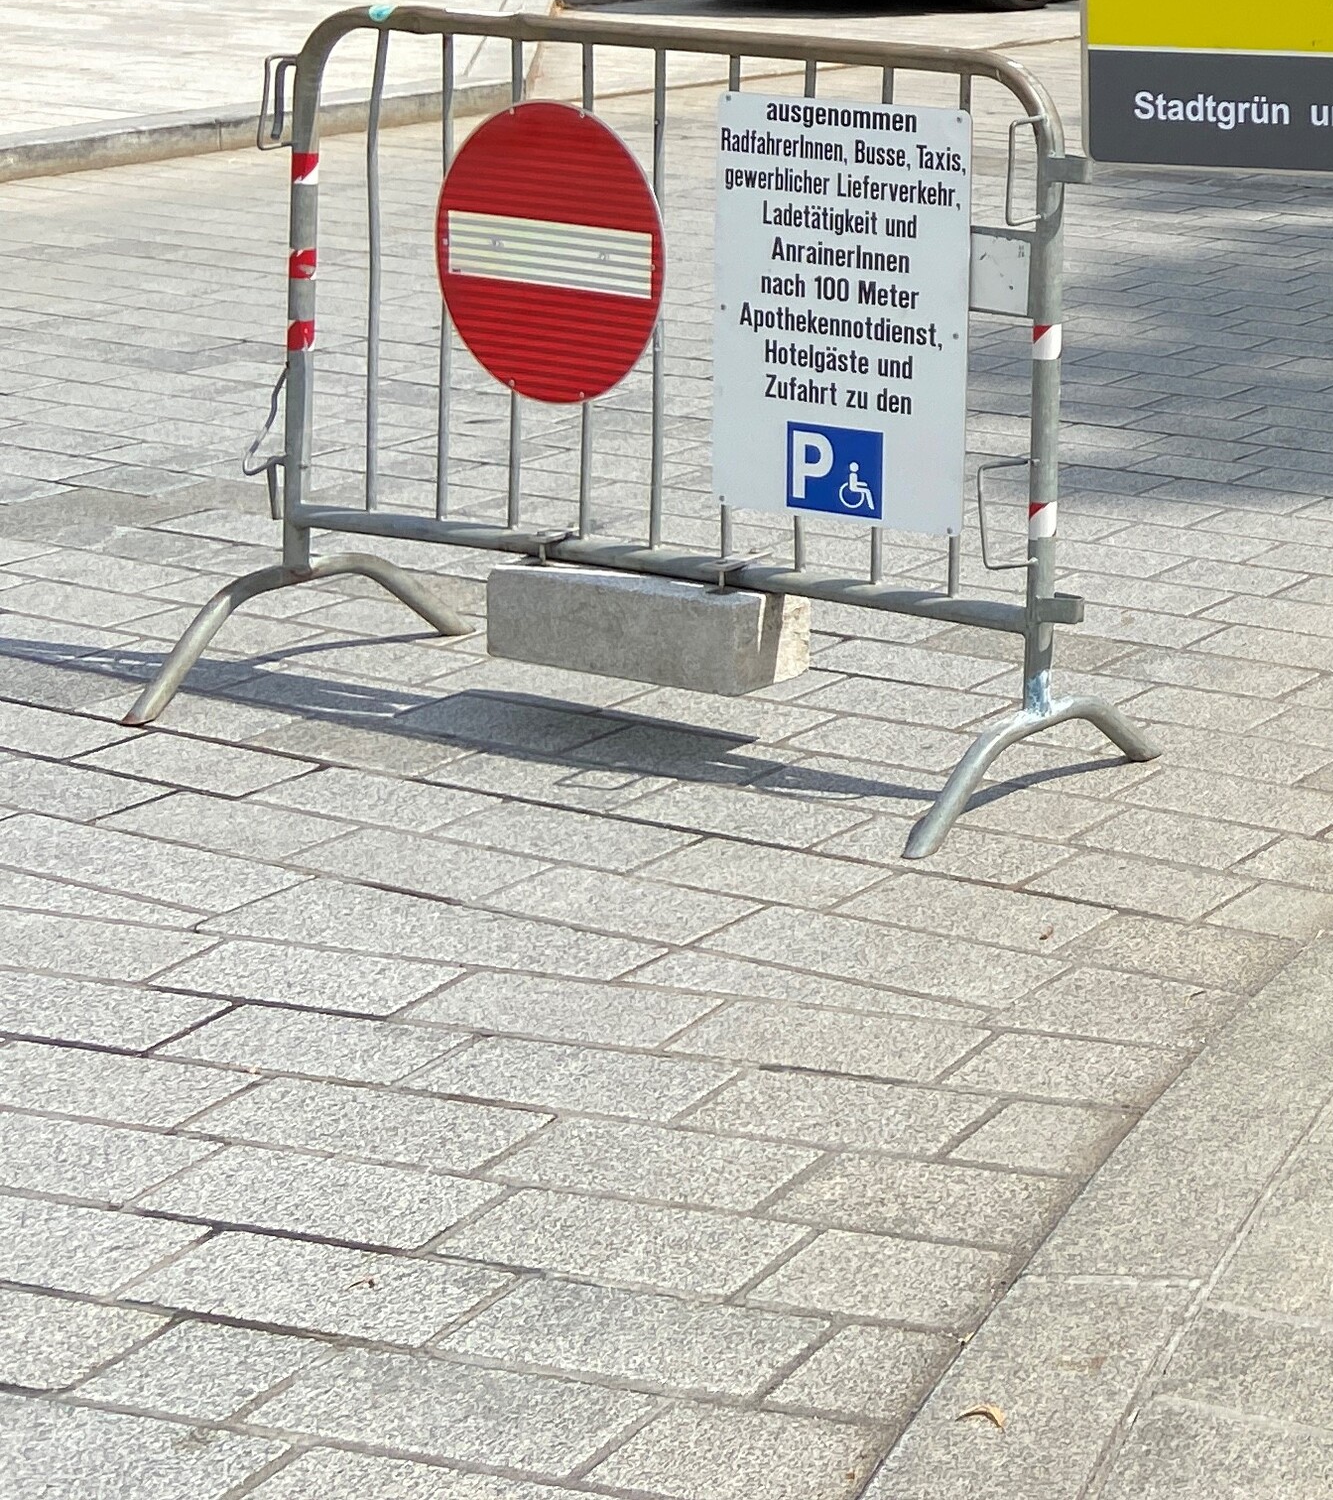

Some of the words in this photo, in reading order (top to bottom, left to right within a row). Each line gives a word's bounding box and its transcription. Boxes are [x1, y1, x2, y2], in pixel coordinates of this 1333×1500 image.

[766, 102, 918, 133] ausgenommen
[1132, 90, 1291, 131] Stadtgrün
[720, 127, 848, 166] RadfahrerInnen,
[854, 139, 912, 171] Busse,
[916, 144, 967, 176] Taxis,
[724, 166, 830, 195] gewerblicher
[837, 172, 962, 211] Lieferverkehr,
[762, 200, 878, 236] Ladetätigkeit
[885, 215, 918, 238] und
[770, 236, 910, 274] AnrainerInnen
[760, 273, 806, 298] nach
[814, 275, 849, 302] 100
[857, 280, 920, 310] Meter
[739, 301, 943, 351] Apothekennotdienst,
[764, 338, 869, 375] Hotelgäste
[877, 355, 913, 380] und
[764, 373, 838, 406] Zufahrt
[845, 389, 868, 410] zu
[876, 387, 912, 415] den
[792, 429, 834, 499] P
